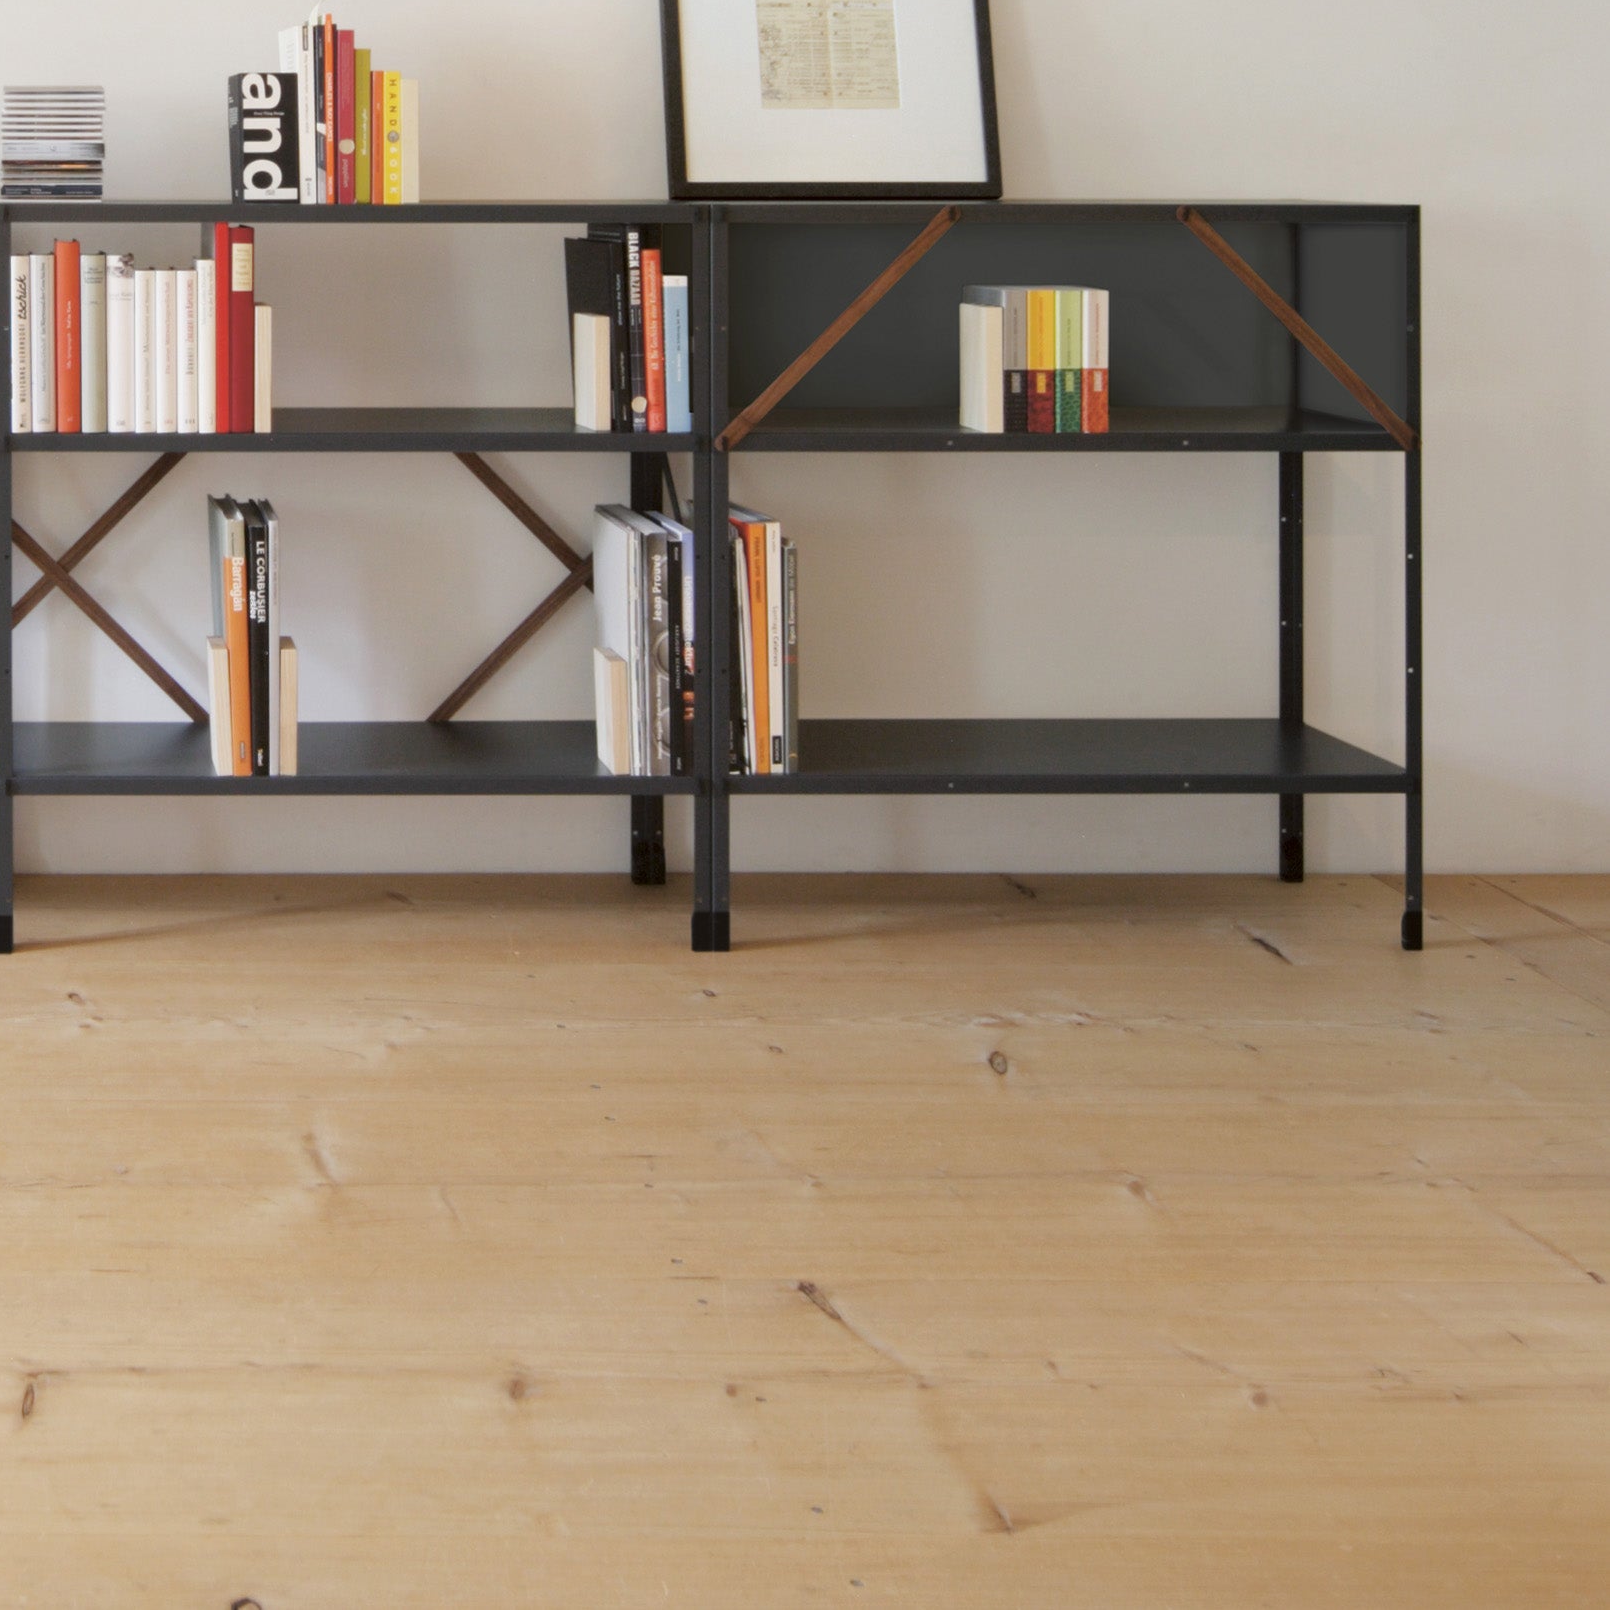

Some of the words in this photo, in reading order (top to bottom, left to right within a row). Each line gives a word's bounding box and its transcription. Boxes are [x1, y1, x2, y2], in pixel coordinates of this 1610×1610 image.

[241, 73, 297, 200] and
[628, 232, 639, 268] BLACK
[15, 274, 27, 320] tschick
[629, 269, 641, 306] BAZAAR
[255, 541, 265, 555] LE
[229, 556, 247, 612] Barragán
[256, 557, 266, 623] CORBUSIER
[651, 553, 662, 594] Prouvé
[652, 595, 663, 622] Jean
